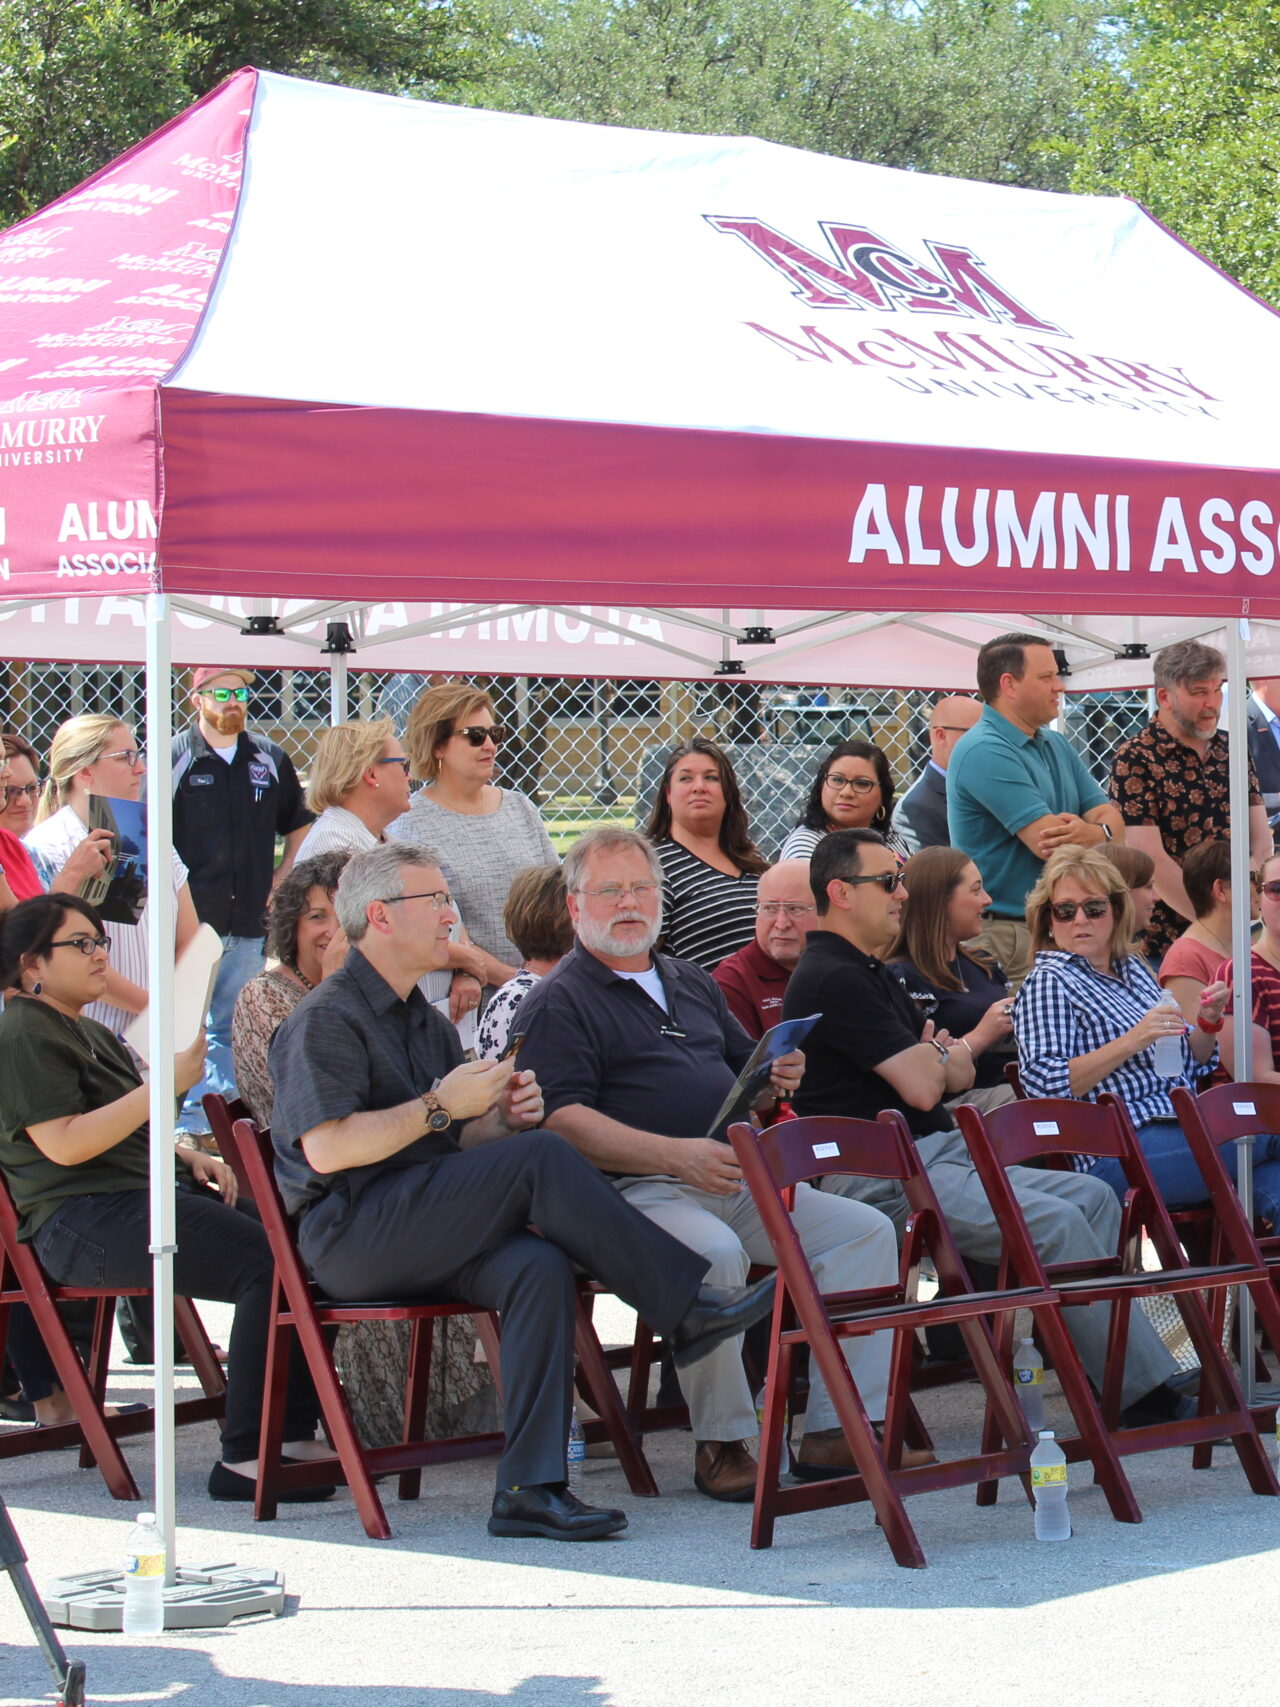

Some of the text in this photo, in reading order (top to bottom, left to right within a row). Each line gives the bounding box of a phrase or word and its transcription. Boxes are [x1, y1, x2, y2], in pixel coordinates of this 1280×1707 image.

[736, 321, 1224, 402] McMURRY
[887, 376, 1220, 420] UNIVERSITY
[848, 483, 1130, 571] ALUMNI
